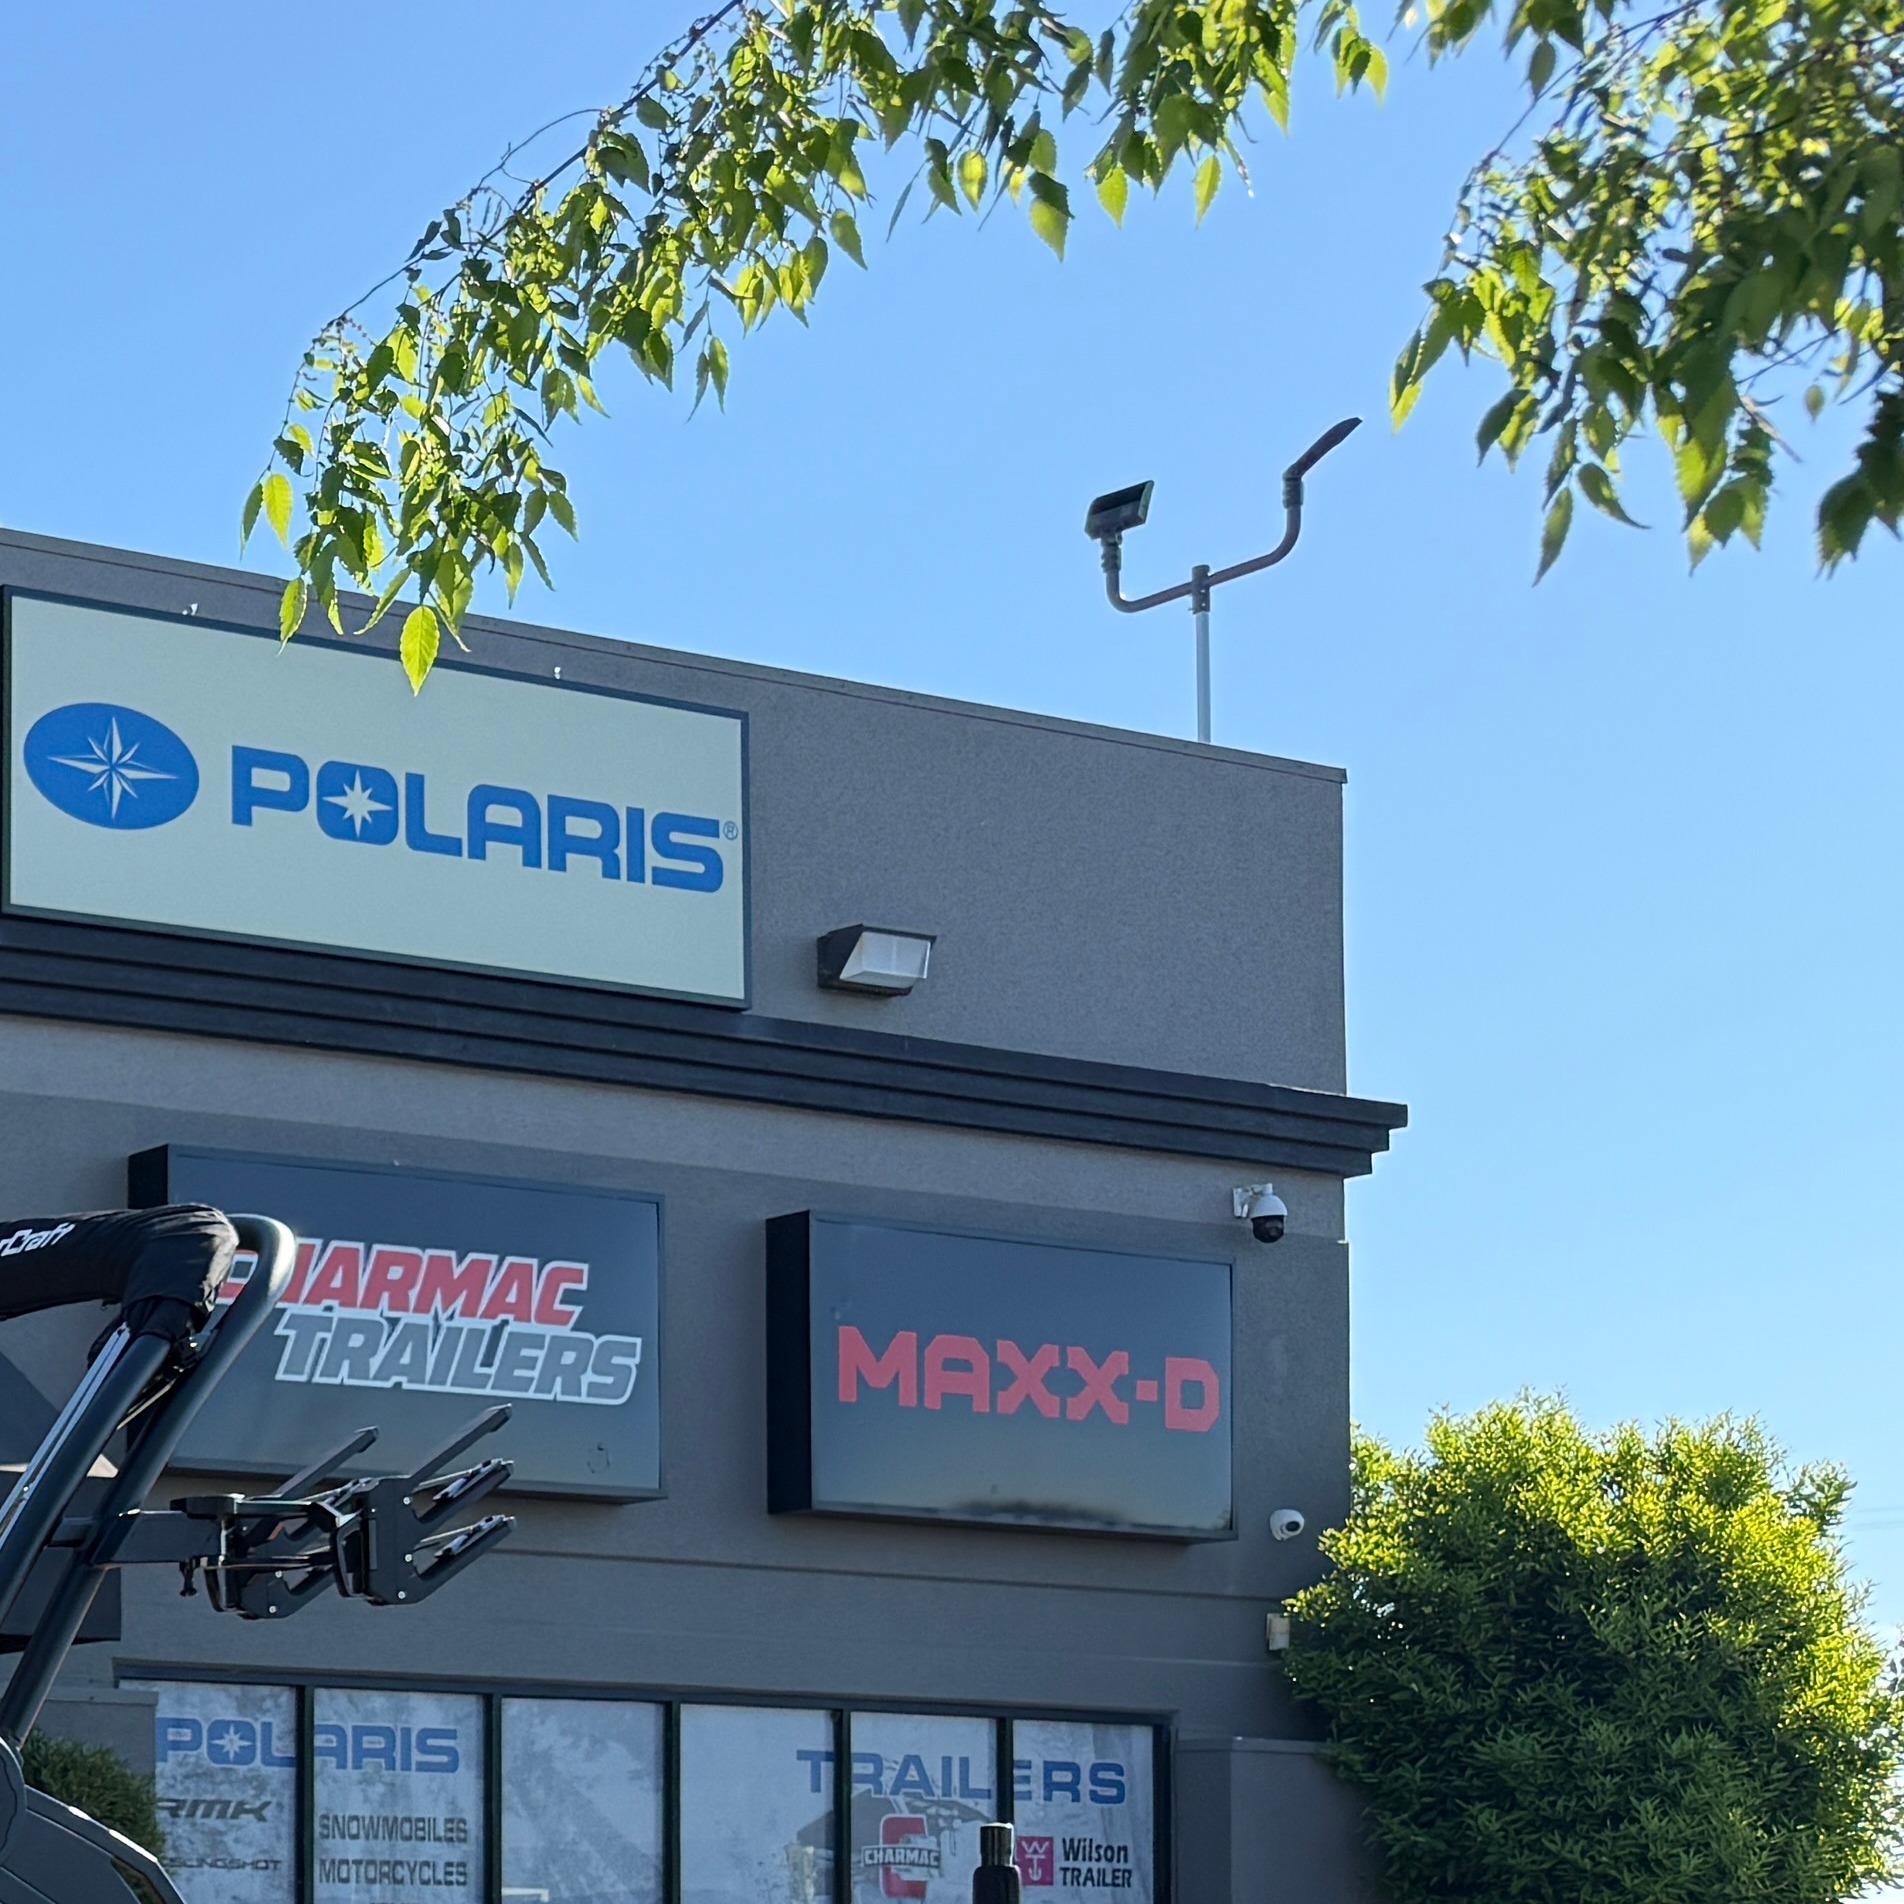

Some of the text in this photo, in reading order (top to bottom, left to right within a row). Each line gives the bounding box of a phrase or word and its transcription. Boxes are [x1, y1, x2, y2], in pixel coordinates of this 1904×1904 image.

[275, 1307, 642, 1406] TRAILERS
[838, 1325, 1220, 1432] MAXX-D
[156, 1717, 459, 1773] POLARIS
[796, 1749, 1126, 1805] TRAILERS
[318, 1813, 468, 1843] SNOWMOBILES
[865, 1848, 940, 1867] CHARMAC
[1062, 1837, 1129, 1864] Wilson
[319, 1858, 468, 1887] MOTORCYCLES
[1059, 1867, 1132, 1888] TRAILER
